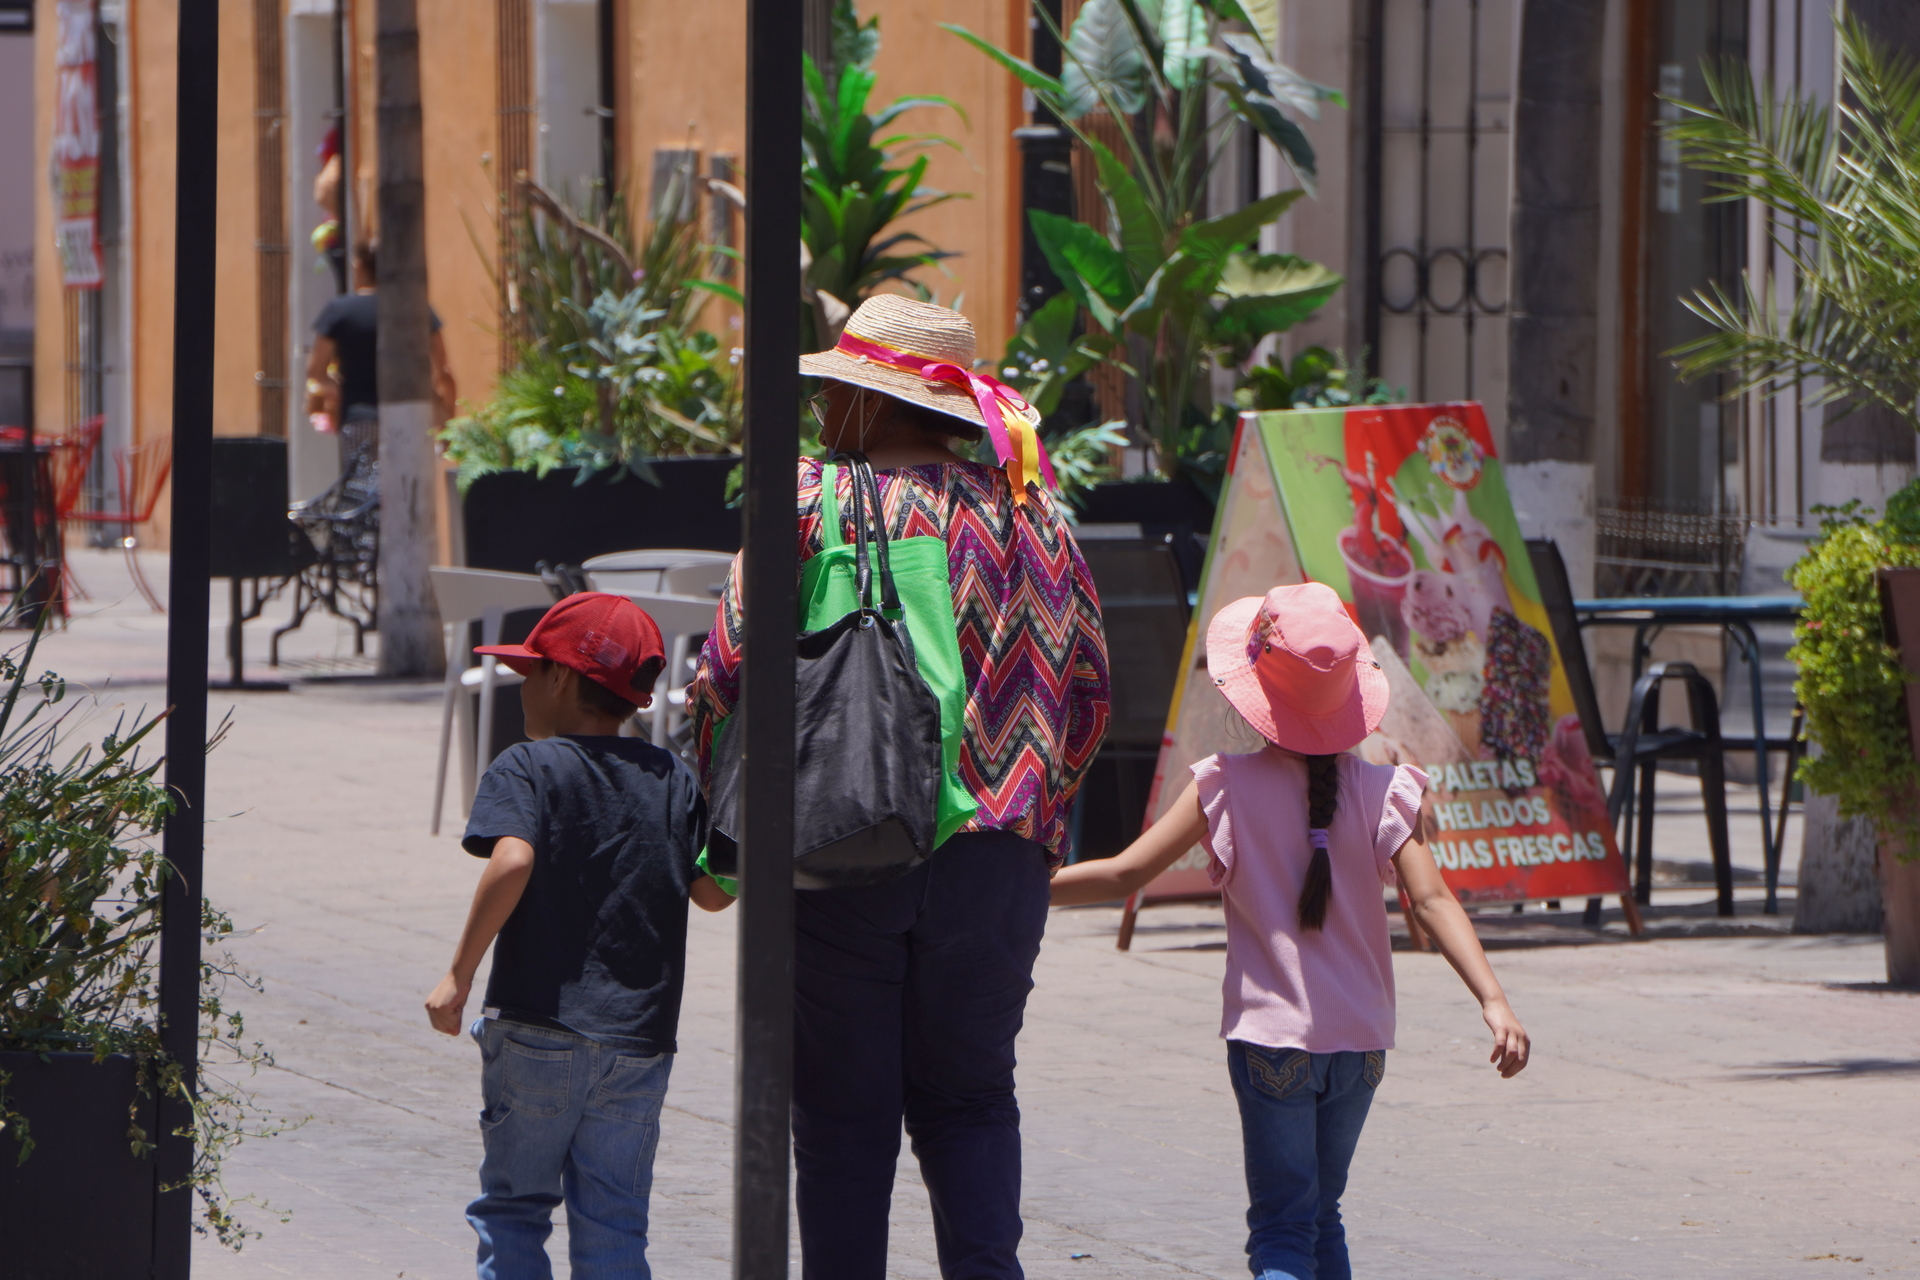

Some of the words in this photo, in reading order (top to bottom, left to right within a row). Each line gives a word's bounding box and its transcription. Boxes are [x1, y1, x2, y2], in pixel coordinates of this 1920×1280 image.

[1425, 758, 1536, 793] PALETAS
[1433, 796, 1551, 831] HELADOS
[1428, 838, 1494, 871] GUAS
[1492, 831, 1607, 868] FRESCAS
